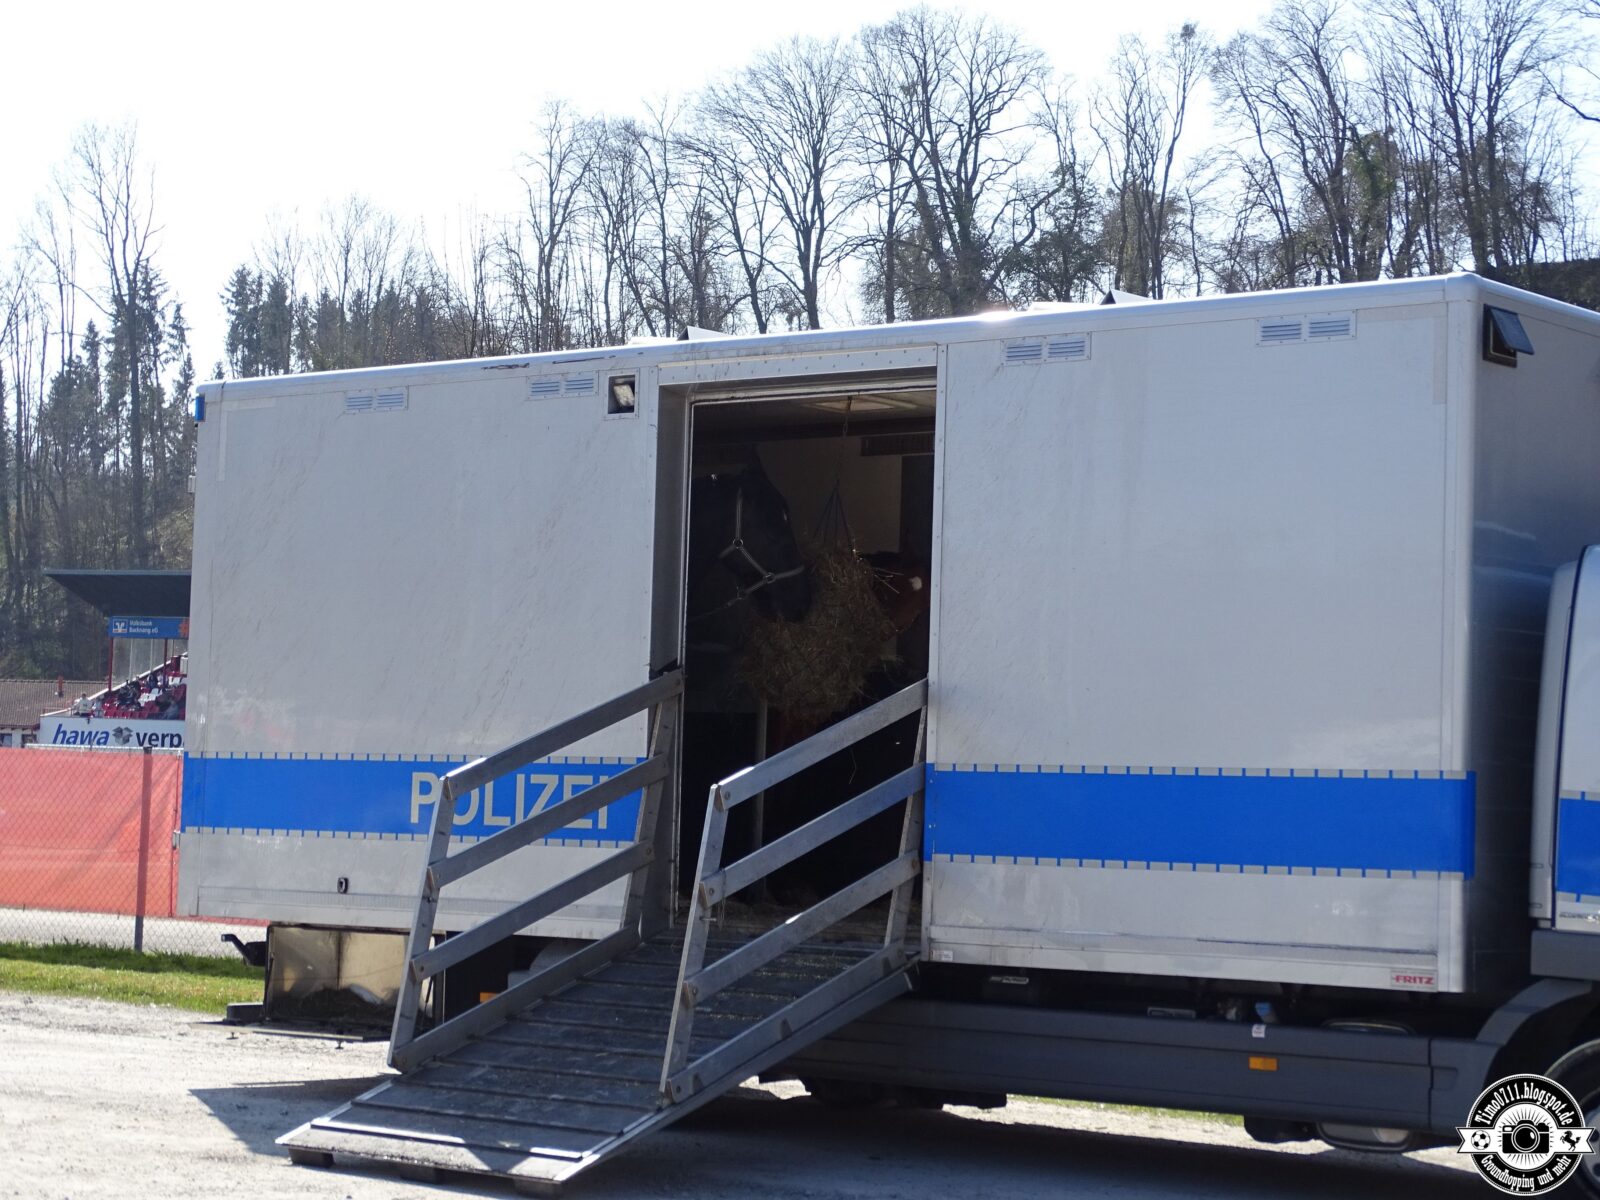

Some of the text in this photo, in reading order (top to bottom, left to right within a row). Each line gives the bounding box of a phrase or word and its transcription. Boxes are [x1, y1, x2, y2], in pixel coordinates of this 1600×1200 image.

[52, 723, 184, 748] hawa verp
[1394, 975, 1435, 986] FRITZ
